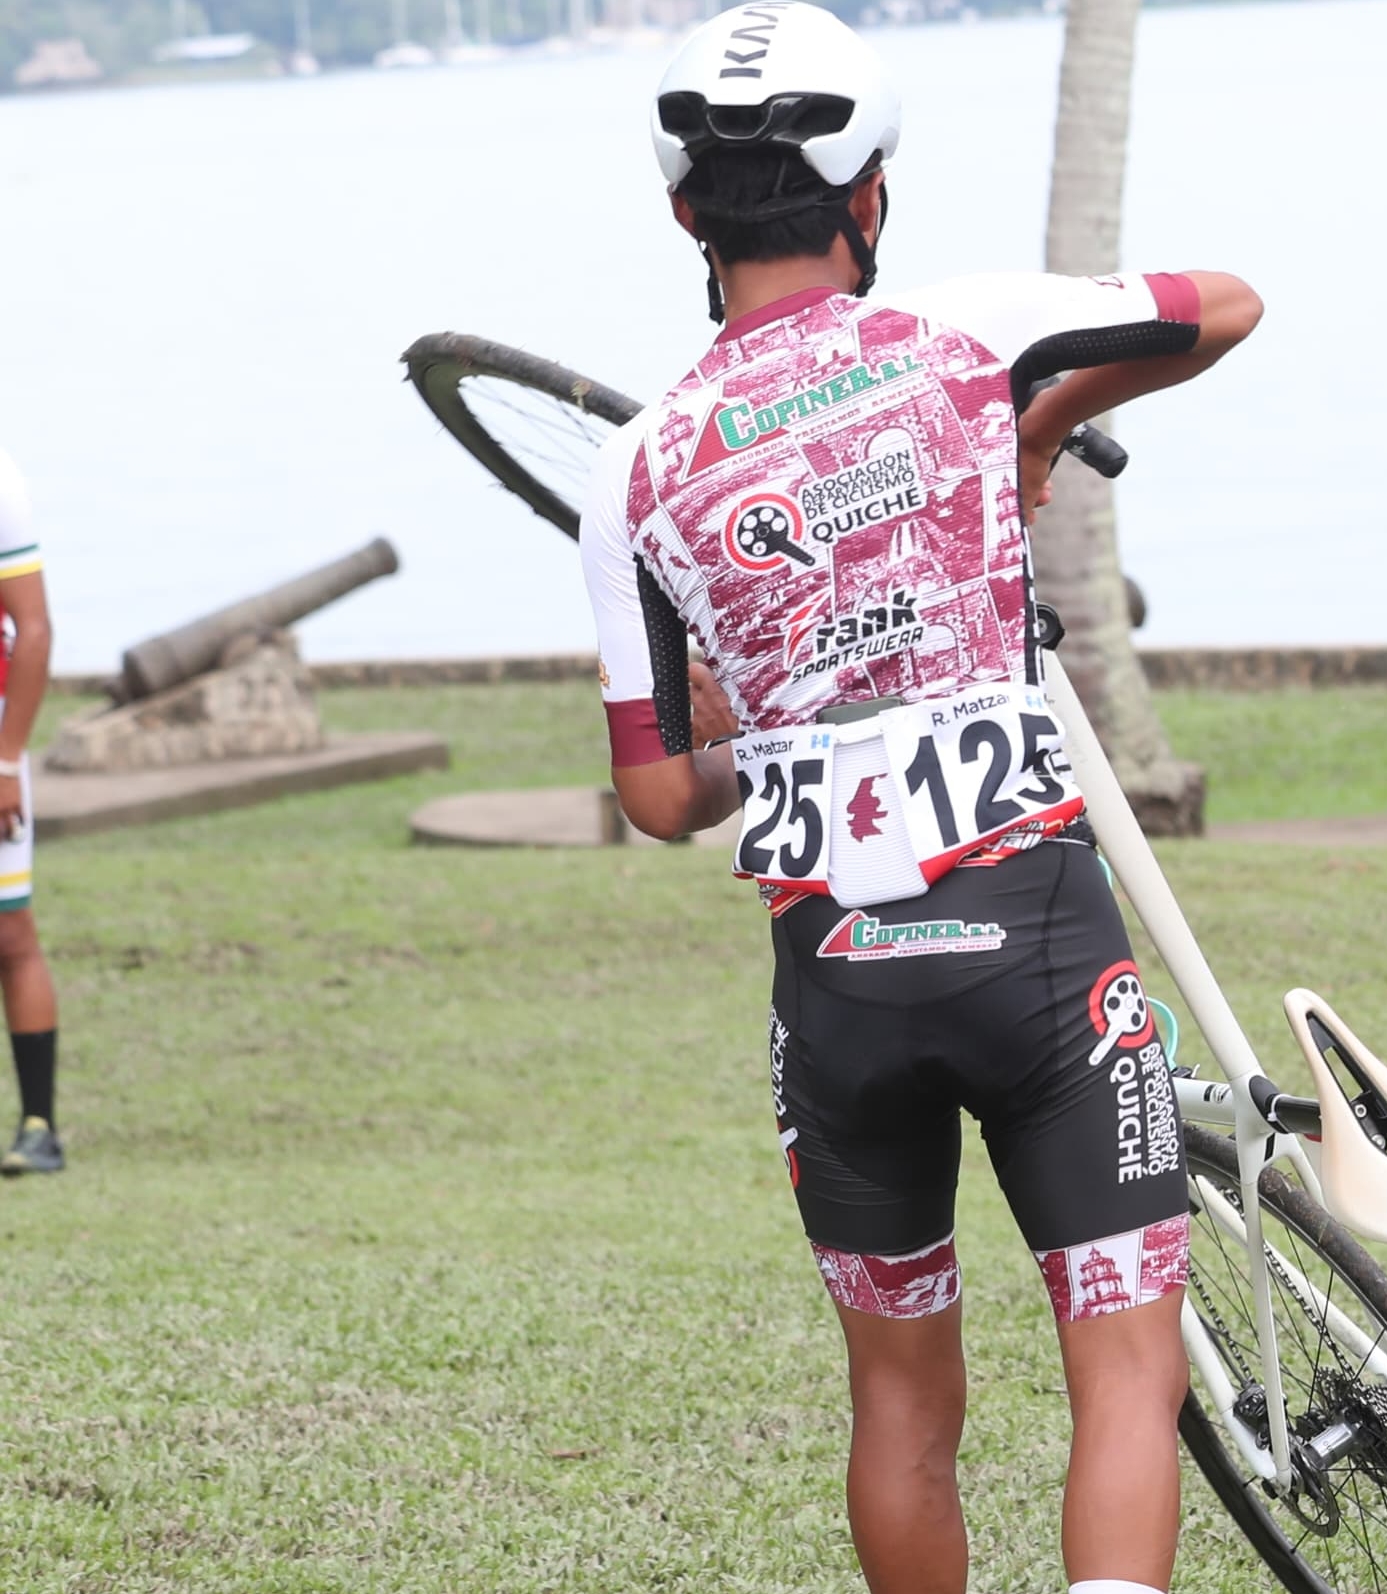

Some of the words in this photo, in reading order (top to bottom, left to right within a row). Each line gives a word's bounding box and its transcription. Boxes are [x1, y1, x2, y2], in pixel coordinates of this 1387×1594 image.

[802, 450, 911, 499] ASOCIACIÓN
[804, 504, 829, 520] DE
[832, 470, 915, 509] CICLISMO
[812, 483, 922, 543] QUICHÉ
[791, 626, 924, 685] SPORTSWEAR
[931, 711, 952, 728] R.
[736, 748, 752, 763] R.
[752, 739, 794, 759] Matzar
[904, 712, 1066, 852] 125
[1110, 1056, 1149, 1184] QUICHÉ
[1144, 1077, 1163, 1176] CICLISMO
